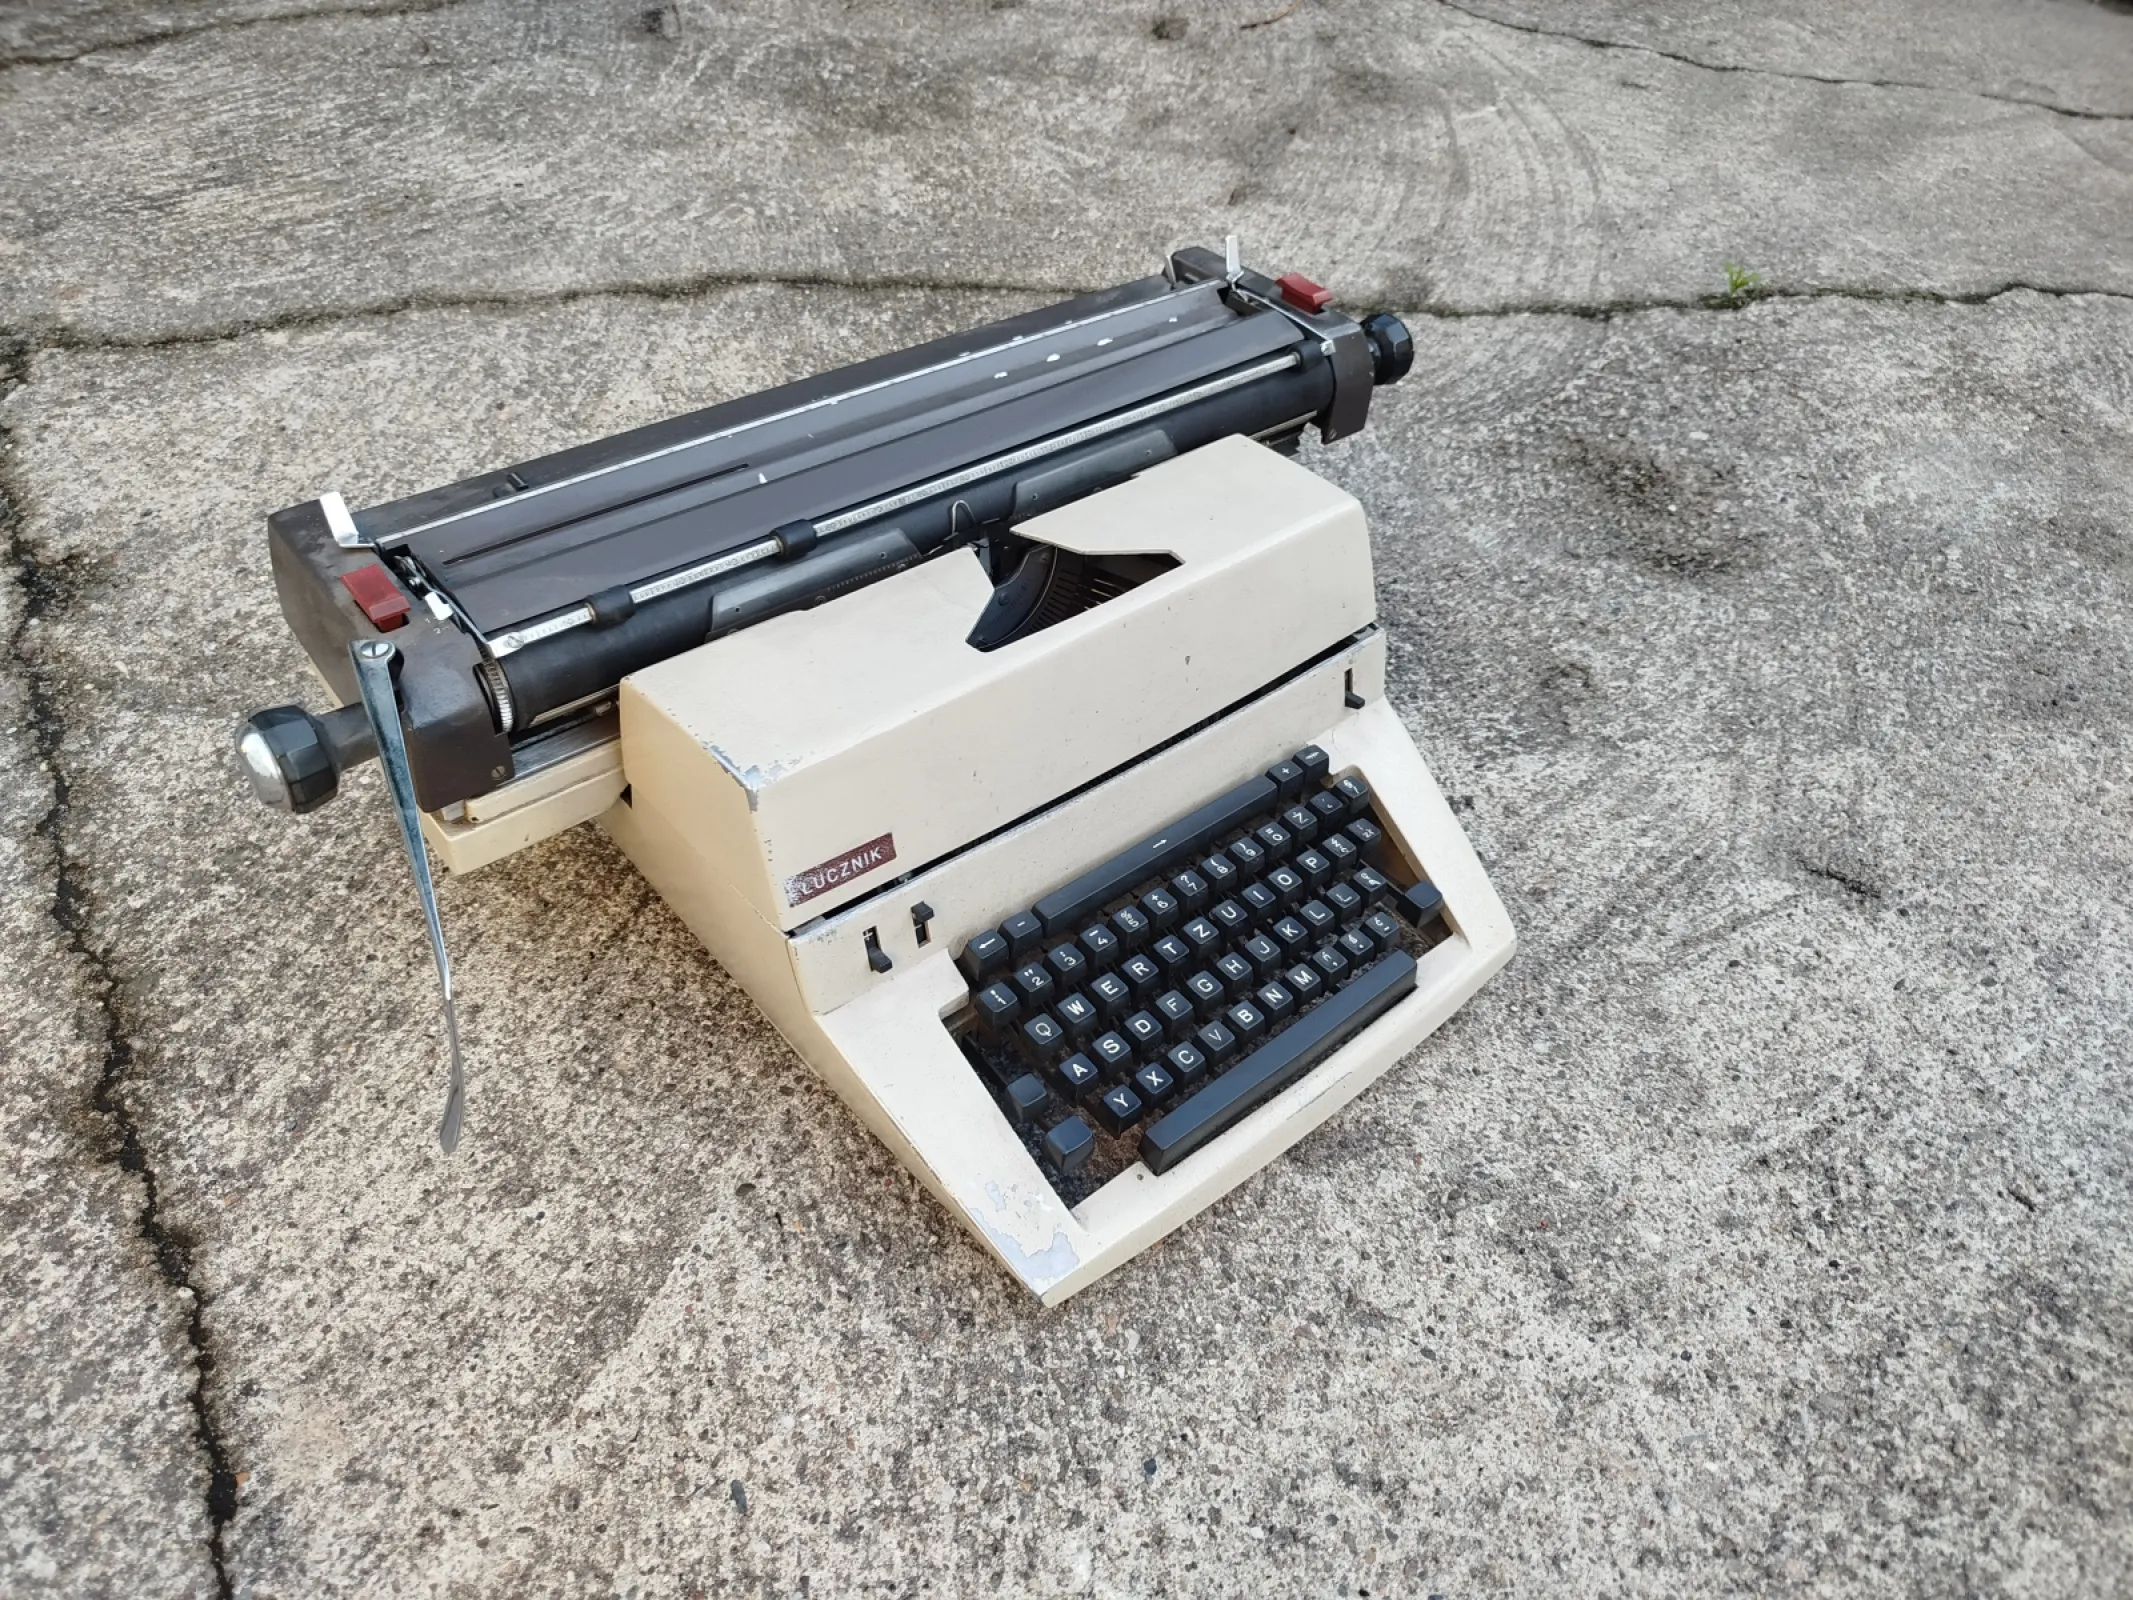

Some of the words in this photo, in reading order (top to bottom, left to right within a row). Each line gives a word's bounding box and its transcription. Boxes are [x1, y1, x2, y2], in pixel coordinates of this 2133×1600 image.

[1035, 1022, 1052, 1037] Q
[1067, 1000, 1085, 1016] W
[1100, 980, 1119, 996] E
[1131, 962, 1150, 976] R
[1162, 942, 1177, 955] T
[1192, 924, 1211, 938] Z
[1221, 906, 1237, 919] U
[1252, 890, 1265, 901] I
[1277, 873, 1293, 885] O
[1304, 857, 1318, 869] P
[1072, 1063, 1088, 1077] A
[1103, 1039, 1120, 1053] S
[1134, 1019, 1151, 1033] D
[1166, 997, 1178, 1012] F
[1196, 979, 1213, 993] G
[1225, 959, 1243, 974] H
[1259, 941, 1270, 954] J
[1281, 923, 1299, 937] K
[1308, 909, 1326, 920] L
[1113, 1093, 1129, 1108] Y
[1145, 1071, 1164, 1087] X
[1178, 1050, 1194, 1065] C
[1208, 1028, 1222, 1042] V
[1237, 1008, 1254, 1024] B
[1265, 988, 1283, 1003] N
[1294, 970, 1313, 985] M
